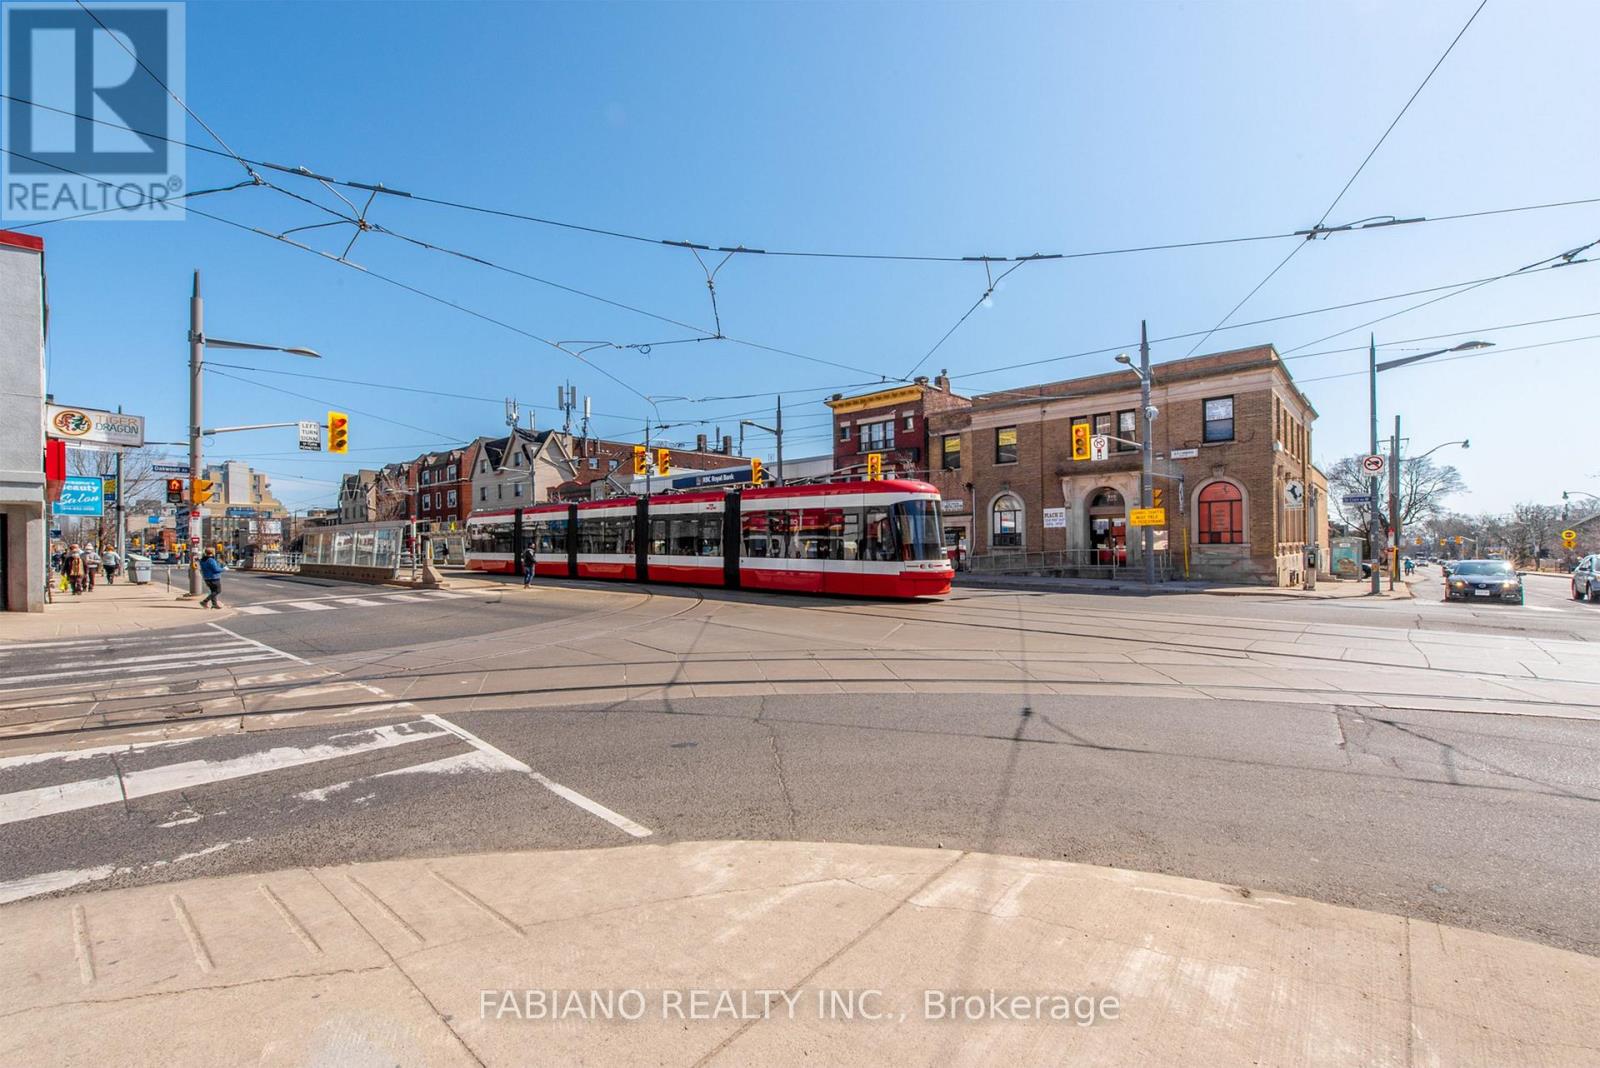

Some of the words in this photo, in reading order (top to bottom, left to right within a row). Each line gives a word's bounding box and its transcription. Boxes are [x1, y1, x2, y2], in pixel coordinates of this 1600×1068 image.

[95, 414, 138, 426] TIGER
[95, 422, 139, 434] DRAGON
[57, 493, 98, 504] Salon
